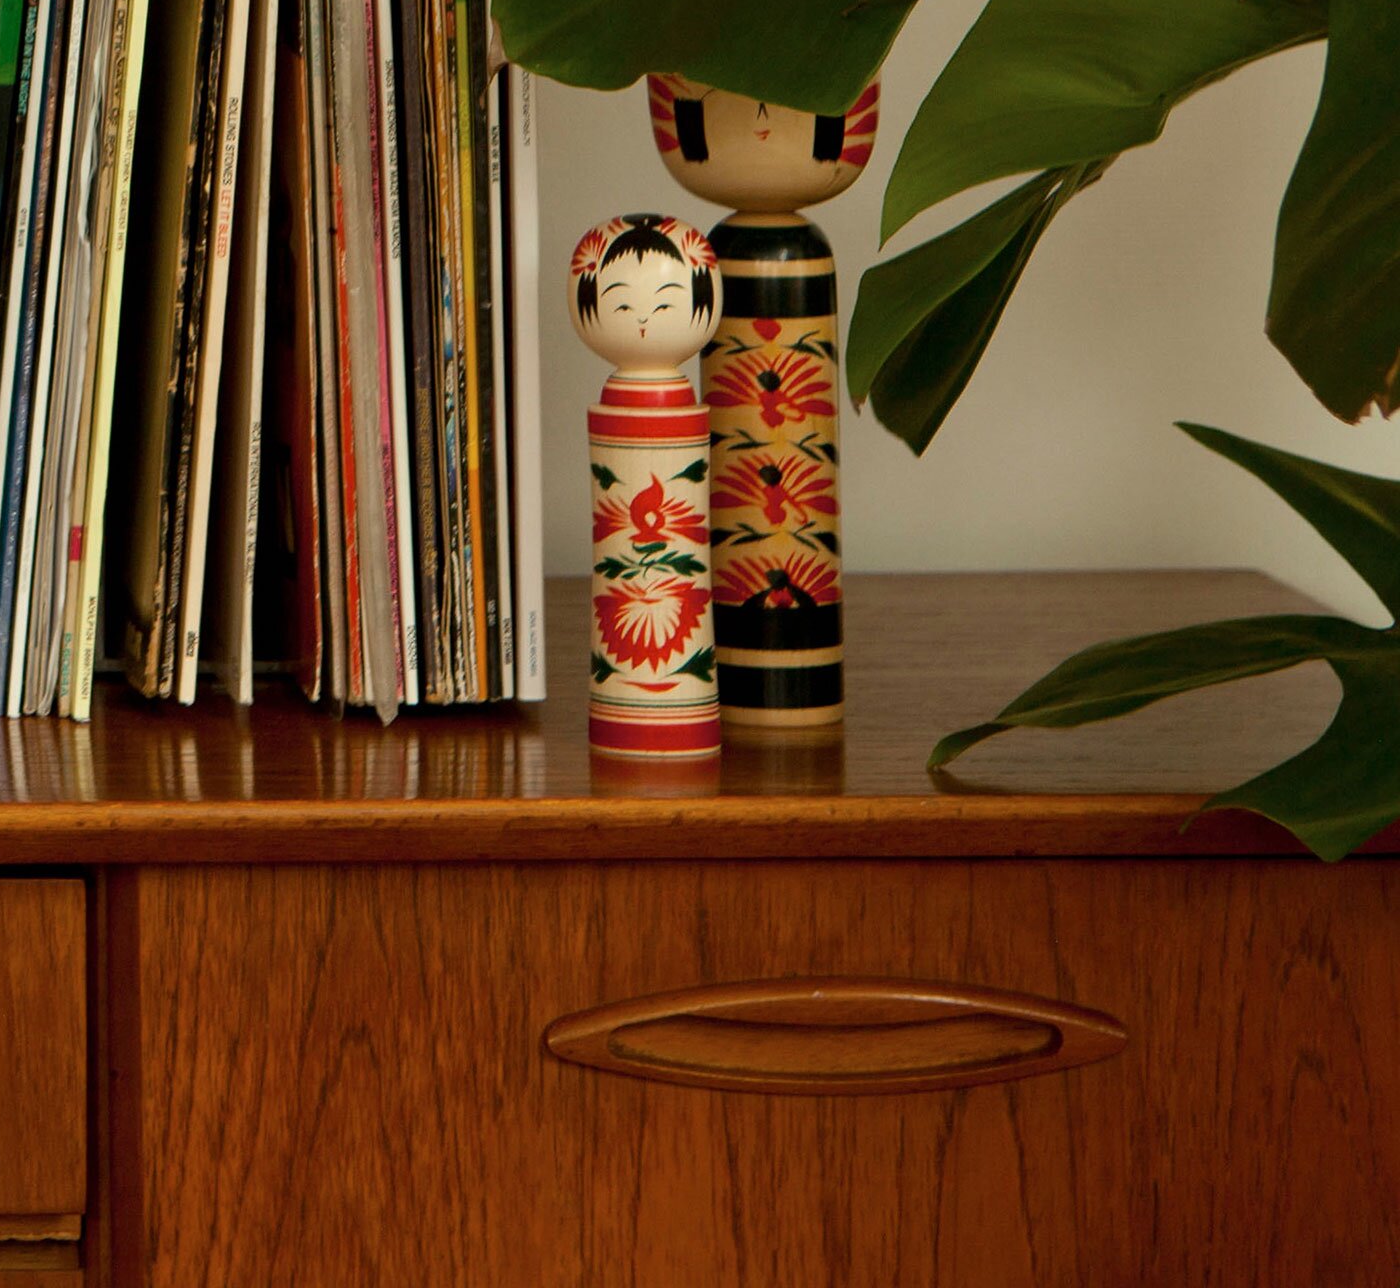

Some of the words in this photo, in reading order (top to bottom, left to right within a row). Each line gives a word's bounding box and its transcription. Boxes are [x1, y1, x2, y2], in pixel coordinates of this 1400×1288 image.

[24, 6, 36, 43] TANGO
[23, 44, 32, 56] IN
[20, 57, 31, 79] THE
[385, 59, 394, 88] SINGS
[17, 80, 29, 115] NIGHT
[386, 91, 395, 106] THE
[225, 97, 238, 140] ROLLING
[386, 109, 396, 142] SONGS
[491, 125, 499, 145] KIND
[222, 144, 234, 185] STONES
[492, 149, 499, 158] OF
[389, 170, 398, 196] MADE
[492, 161, 500, 182] BLUE
[220, 188, 231, 207] LET
[219, 211, 229, 219] IT
[216, 223, 228, 258] BLEED
[390, 219, 400, 259] FAMOUS
[247, 445, 260, 521] INTERNATIONAL
